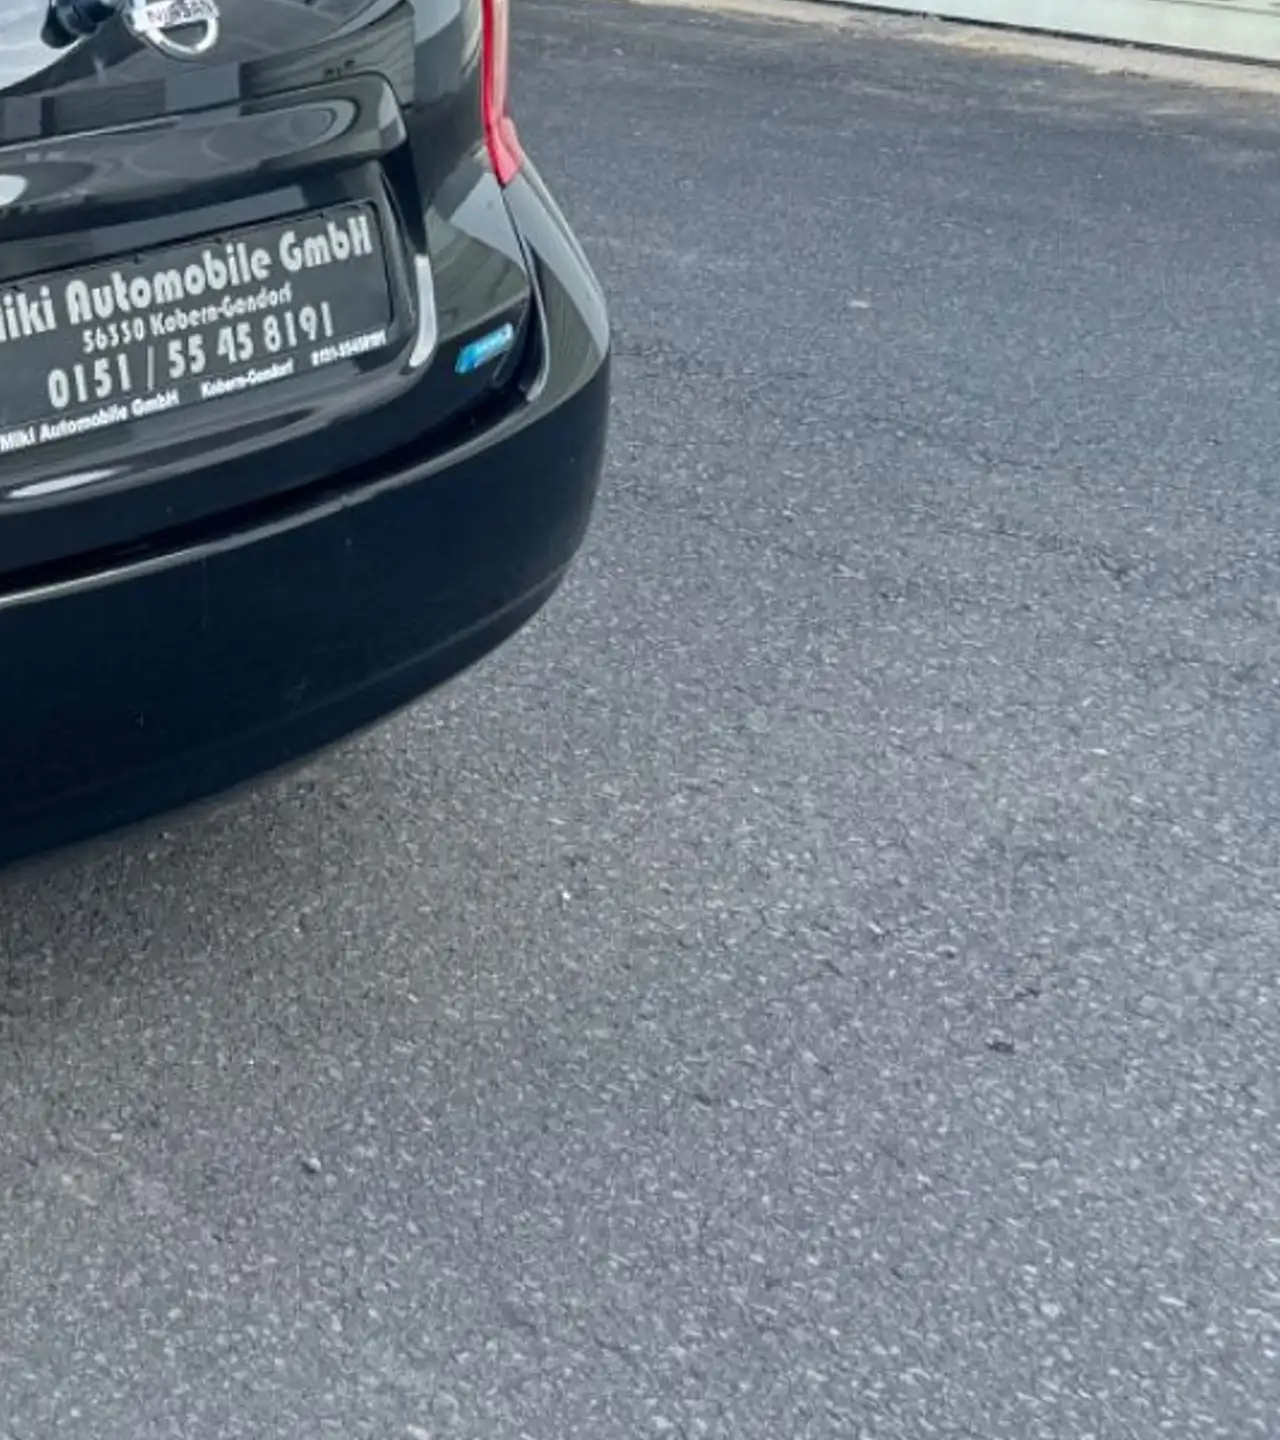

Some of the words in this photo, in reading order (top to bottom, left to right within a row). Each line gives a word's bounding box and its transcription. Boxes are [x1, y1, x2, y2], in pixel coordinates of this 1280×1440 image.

[65, 242, 272, 325] Automobile
[279, 215, 373, 272] GmbH
[47, 353, 132, 409] 0151
[168, 333, 206, 379] 55
[217, 322, 254, 364] 45
[263, 301, 333, 353] 8191
